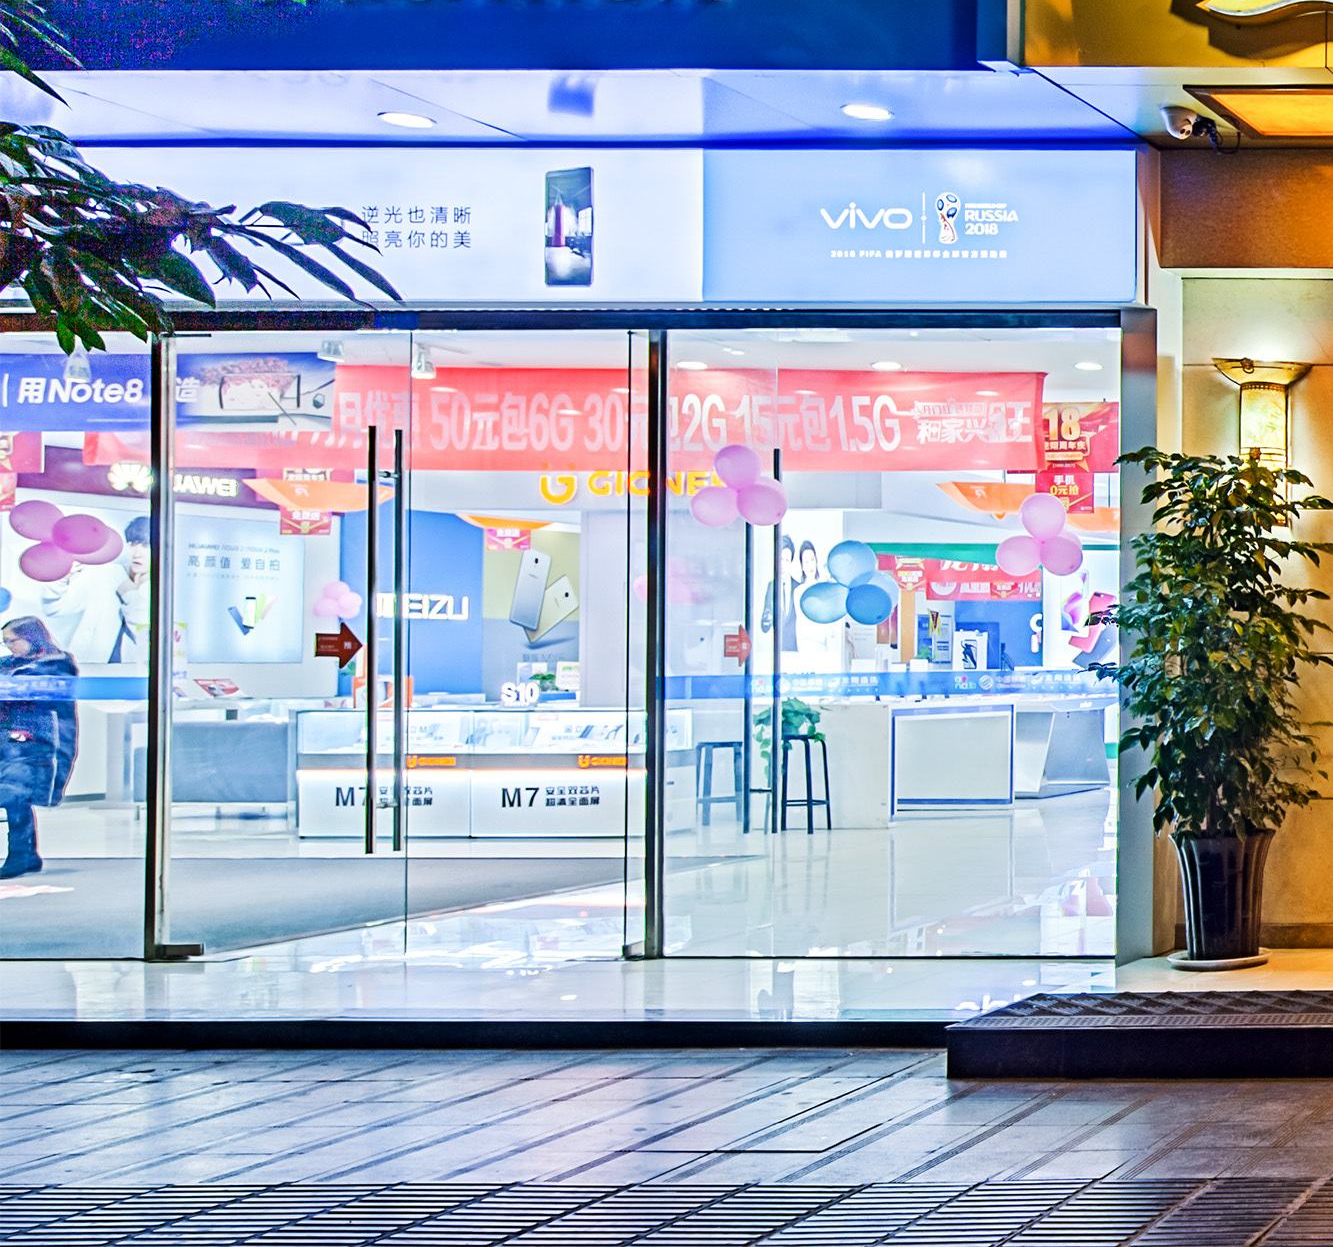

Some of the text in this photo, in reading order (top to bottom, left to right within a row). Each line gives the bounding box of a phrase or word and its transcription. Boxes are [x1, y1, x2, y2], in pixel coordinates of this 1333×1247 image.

[361, 205, 472, 225] 逆光也清晰
[820, 201, 913, 229] vivo
[965, 210, 1019, 222] RUSSIA
[965, 223, 999, 236] 2018
[361, 230, 472, 249] 照亮你的美
[1044, 407, 1081, 441] 18
[173, 474, 239, 497] AWEI
[1054, 475, 1075, 485] 手机
[187, 555, 280, 571] 高颜值 爱自拍
[501, 682, 540, 703] S10
[502, 787, 540, 808] M7
[545, 786, 600, 796] 安全双芯片
